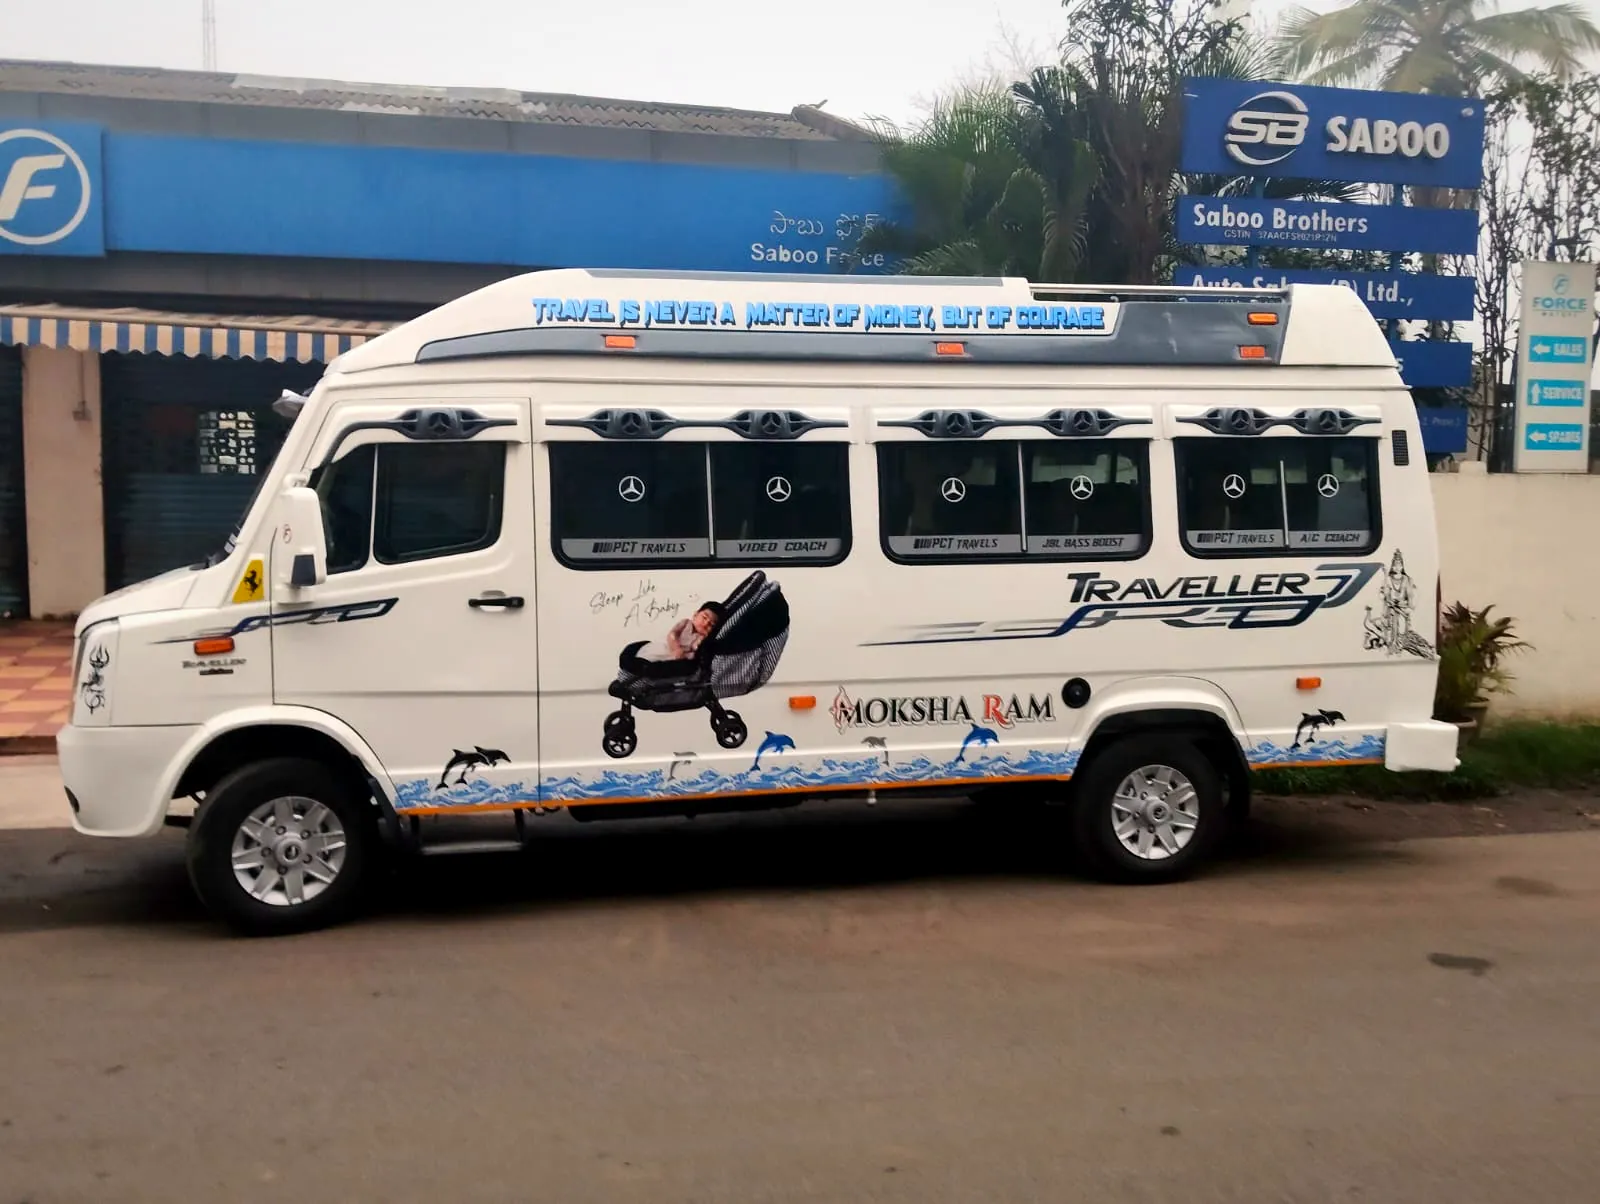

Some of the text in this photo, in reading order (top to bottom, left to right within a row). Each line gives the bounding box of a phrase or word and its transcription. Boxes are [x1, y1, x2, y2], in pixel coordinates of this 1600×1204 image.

[1325, 115, 1450, 159] SABOO
[1193, 203, 1369, 234] Saboo Brothers
[750, 243, 885, 267] Saboo Fce
[1532, 296, 1589, 311] FORCE
[532, 298, 1105, 332] TRAVEL IS NEVER A MATTER OF MONEY, BUT OF COURAGE
[932, 537, 999, 550] PCT TRAVELS
[1042, 536, 1125, 548] JBL BASS BOOST
[1213, 532, 1276, 544] PCT TRAVELS
[1300, 532, 1361, 543] A/C COACH
[612, 541, 687, 554] PCT TRAVELS
[738, 540, 828, 553] VIDEO COACH
[1066, 571, 1311, 603] TRAVELLER
[982, 692, 1057, 730] RAM
